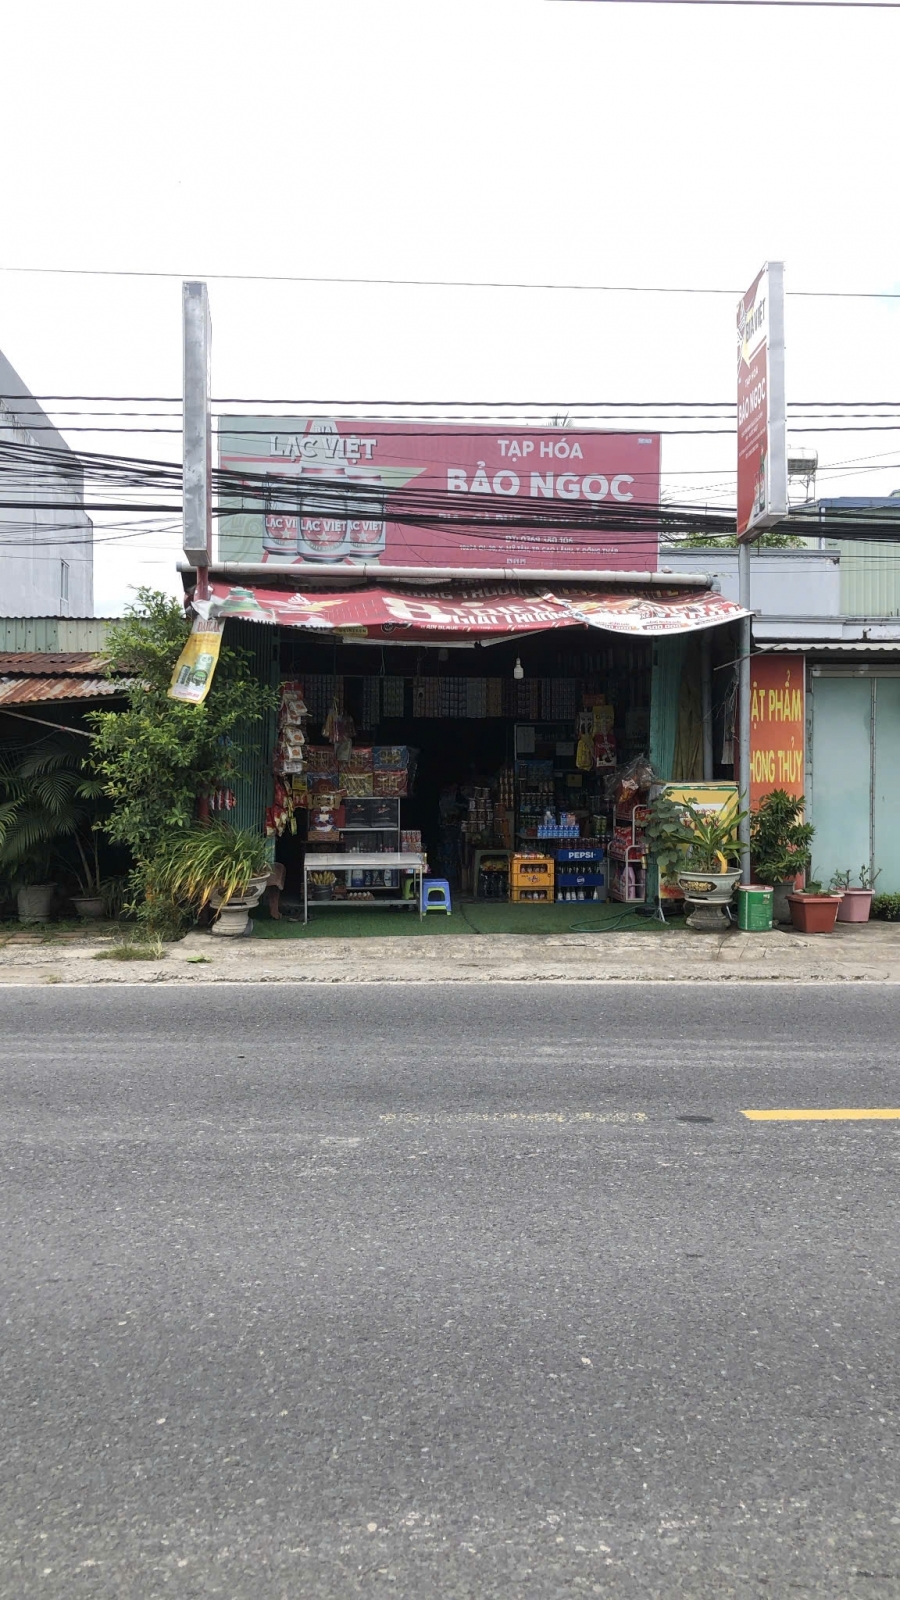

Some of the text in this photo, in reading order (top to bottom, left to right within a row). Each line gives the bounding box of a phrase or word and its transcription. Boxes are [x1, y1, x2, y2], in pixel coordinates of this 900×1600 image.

[749, 378, 766, 413] NGỌC
[269, 434, 378, 465] LẠC VIỆT
[497, 438, 584, 462] TẠP HÓA
[447, 461, 635, 509] BẢO NGỌC
[300, 519, 347, 534] LẠC VIỆT
[750, 669, 802, 730] ẬT PHẨM
[750, 736, 803, 783] HONG THỦY
[568, 851, 594, 859] PEPSI
